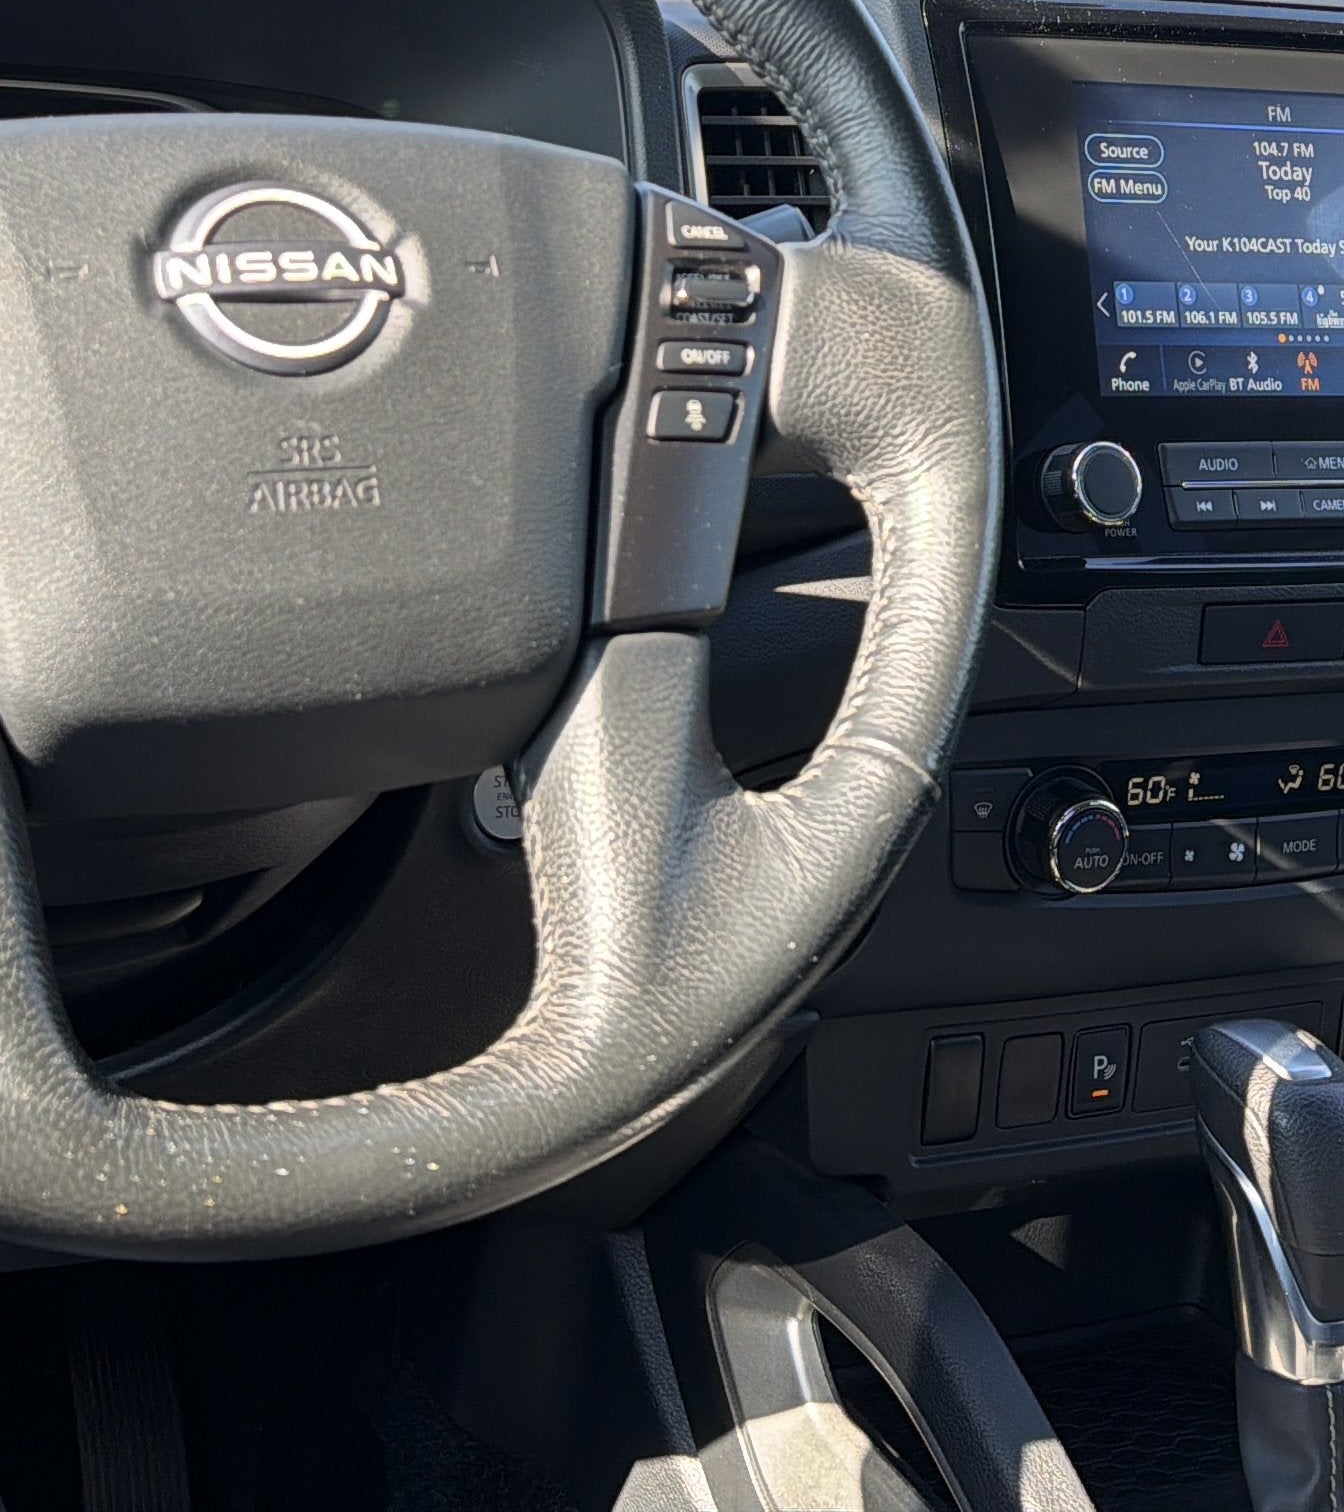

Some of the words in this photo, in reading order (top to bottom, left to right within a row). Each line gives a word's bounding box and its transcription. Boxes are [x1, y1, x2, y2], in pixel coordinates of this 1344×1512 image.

[1267, 105, 1291, 123] FM
[1100, 141, 1149, 159] Source
[1252, 141, 1289, 159] 104.7
[1292, 142, 1315, 159] FM
[1258, 161, 1313, 186] Today
[1094, 178, 1117, 195] FM
[1121, 179, 1162, 196] Menu
[1265, 186, 1292, 204] Top
[1293, 185, 1311, 202] 40
[1185, 236, 1219, 253] Your
[1222, 236, 1292, 255] K104CAST
[1295, 238, 1337, 258] Today
[165, 250, 399, 289] NISSAN
[1121, 309, 1154, 325] 101.5
[1155, 310, 1175, 325] FM
[1183, 310, 1217, 325] 106.1
[1218, 310, 1238, 325] FM
[1246, 311, 1278, 325] 105.5
[1279, 311, 1299, 326] FM
[1111, 378, 1150, 392] Phone
[1173, 379, 1195, 393] Apple
[1196, 378, 1226, 394] CarPlay
[1229, 379, 1244, 392] BT
[1247, 378, 1283, 392] Audio
[1301, 379, 1320, 392] FM
[278, 434, 342, 467] SRS
[1199, 456, 1239, 472] AUDIO
[249, 477, 381, 513] AIRBAG
[1104, 528, 1138, 537] POWER
[1283, 839, 1317, 854] MODE
[1074, 854, 1109, 869] AUTO
